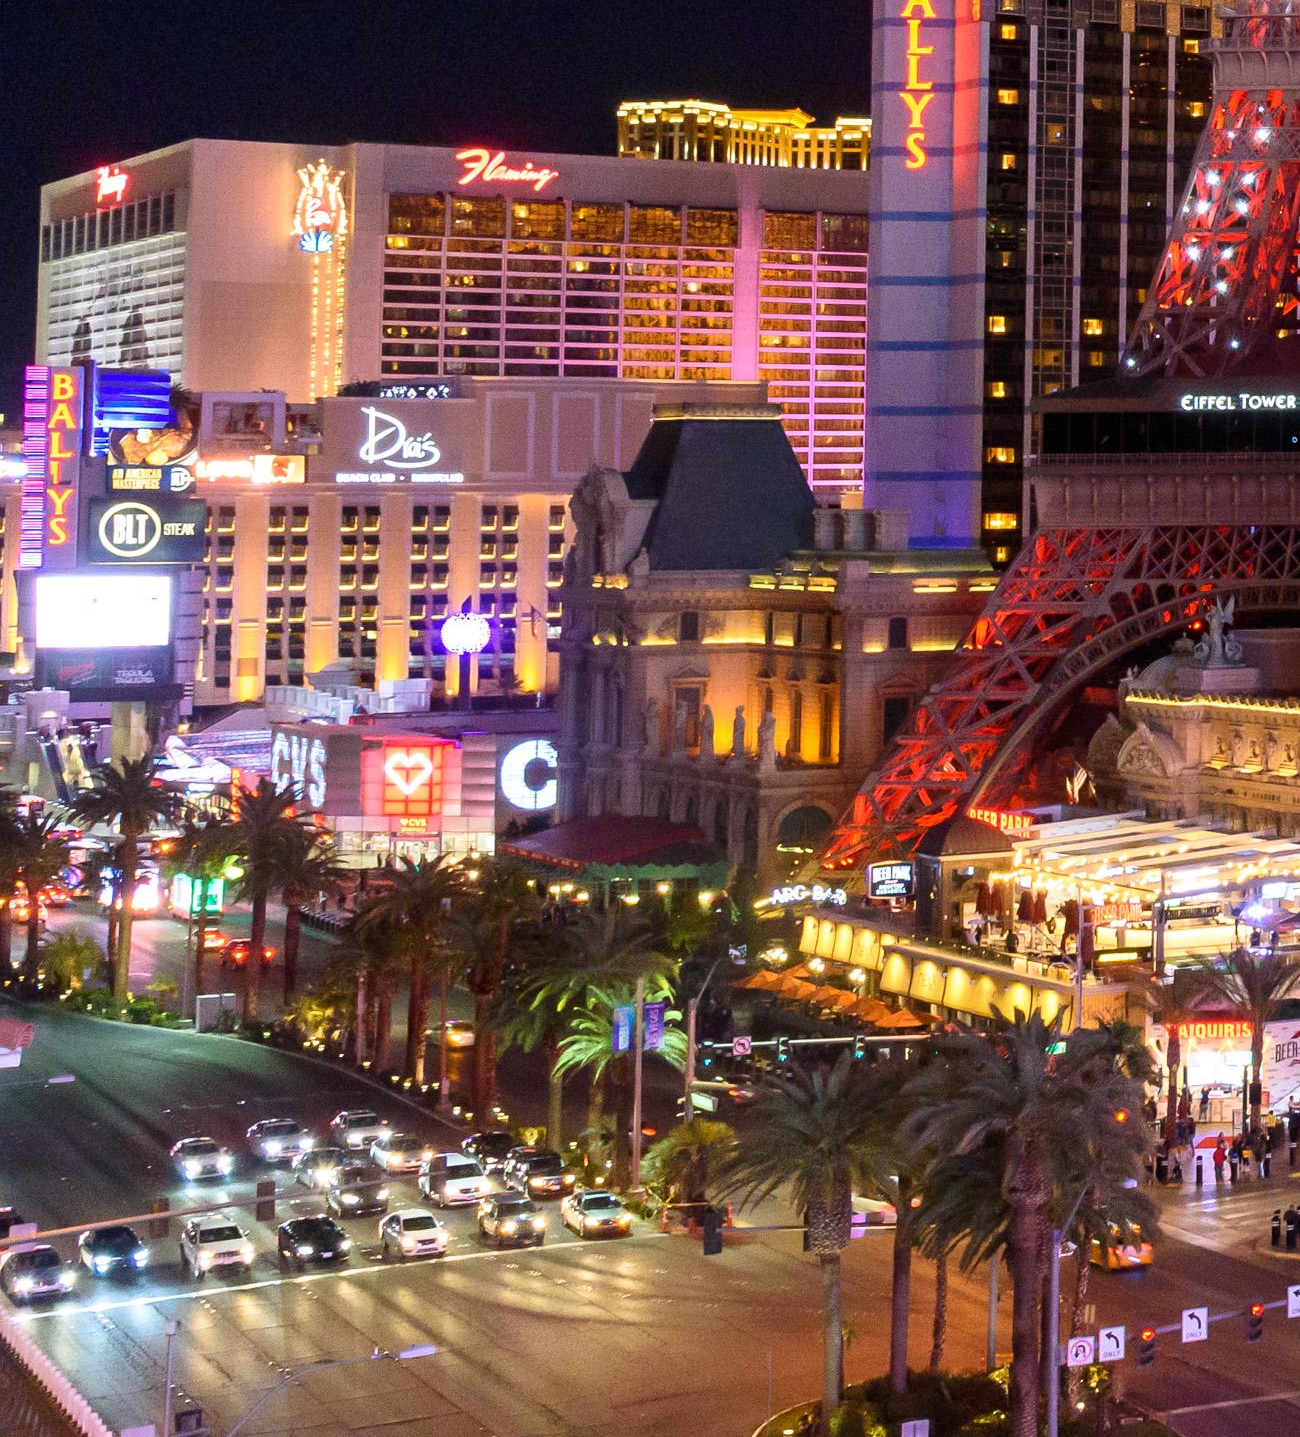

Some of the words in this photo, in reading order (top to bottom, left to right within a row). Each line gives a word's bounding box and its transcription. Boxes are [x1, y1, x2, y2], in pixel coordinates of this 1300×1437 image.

[1181, 395, 1235, 410] EIFFEL
[1239, 394, 1296, 409] TOWER
[360, 406, 441, 468] Drai's
[48, 373, 76, 545] BALLYS
[113, 514, 149, 544] BLT
[163, 523, 195, 536] STEAK
[272, 732, 328, 808] CVS
[970, 809, 997, 827] BEER
[1000, 814, 1032, 838] PARK
[873, 866, 891, 882] BEER
[892, 866, 911, 881] PARK
[1094, 905, 1118, 924] BEER
[1120, 903, 1143, 922] PARK
[1167, 1023, 1252, 1039] AIQUIRIS
[1275, 1042, 1298, 1063] BEER
[1185, 1330, 1202, 1339] ONLY
[1103, 1350, 1121, 1358] ONLY
